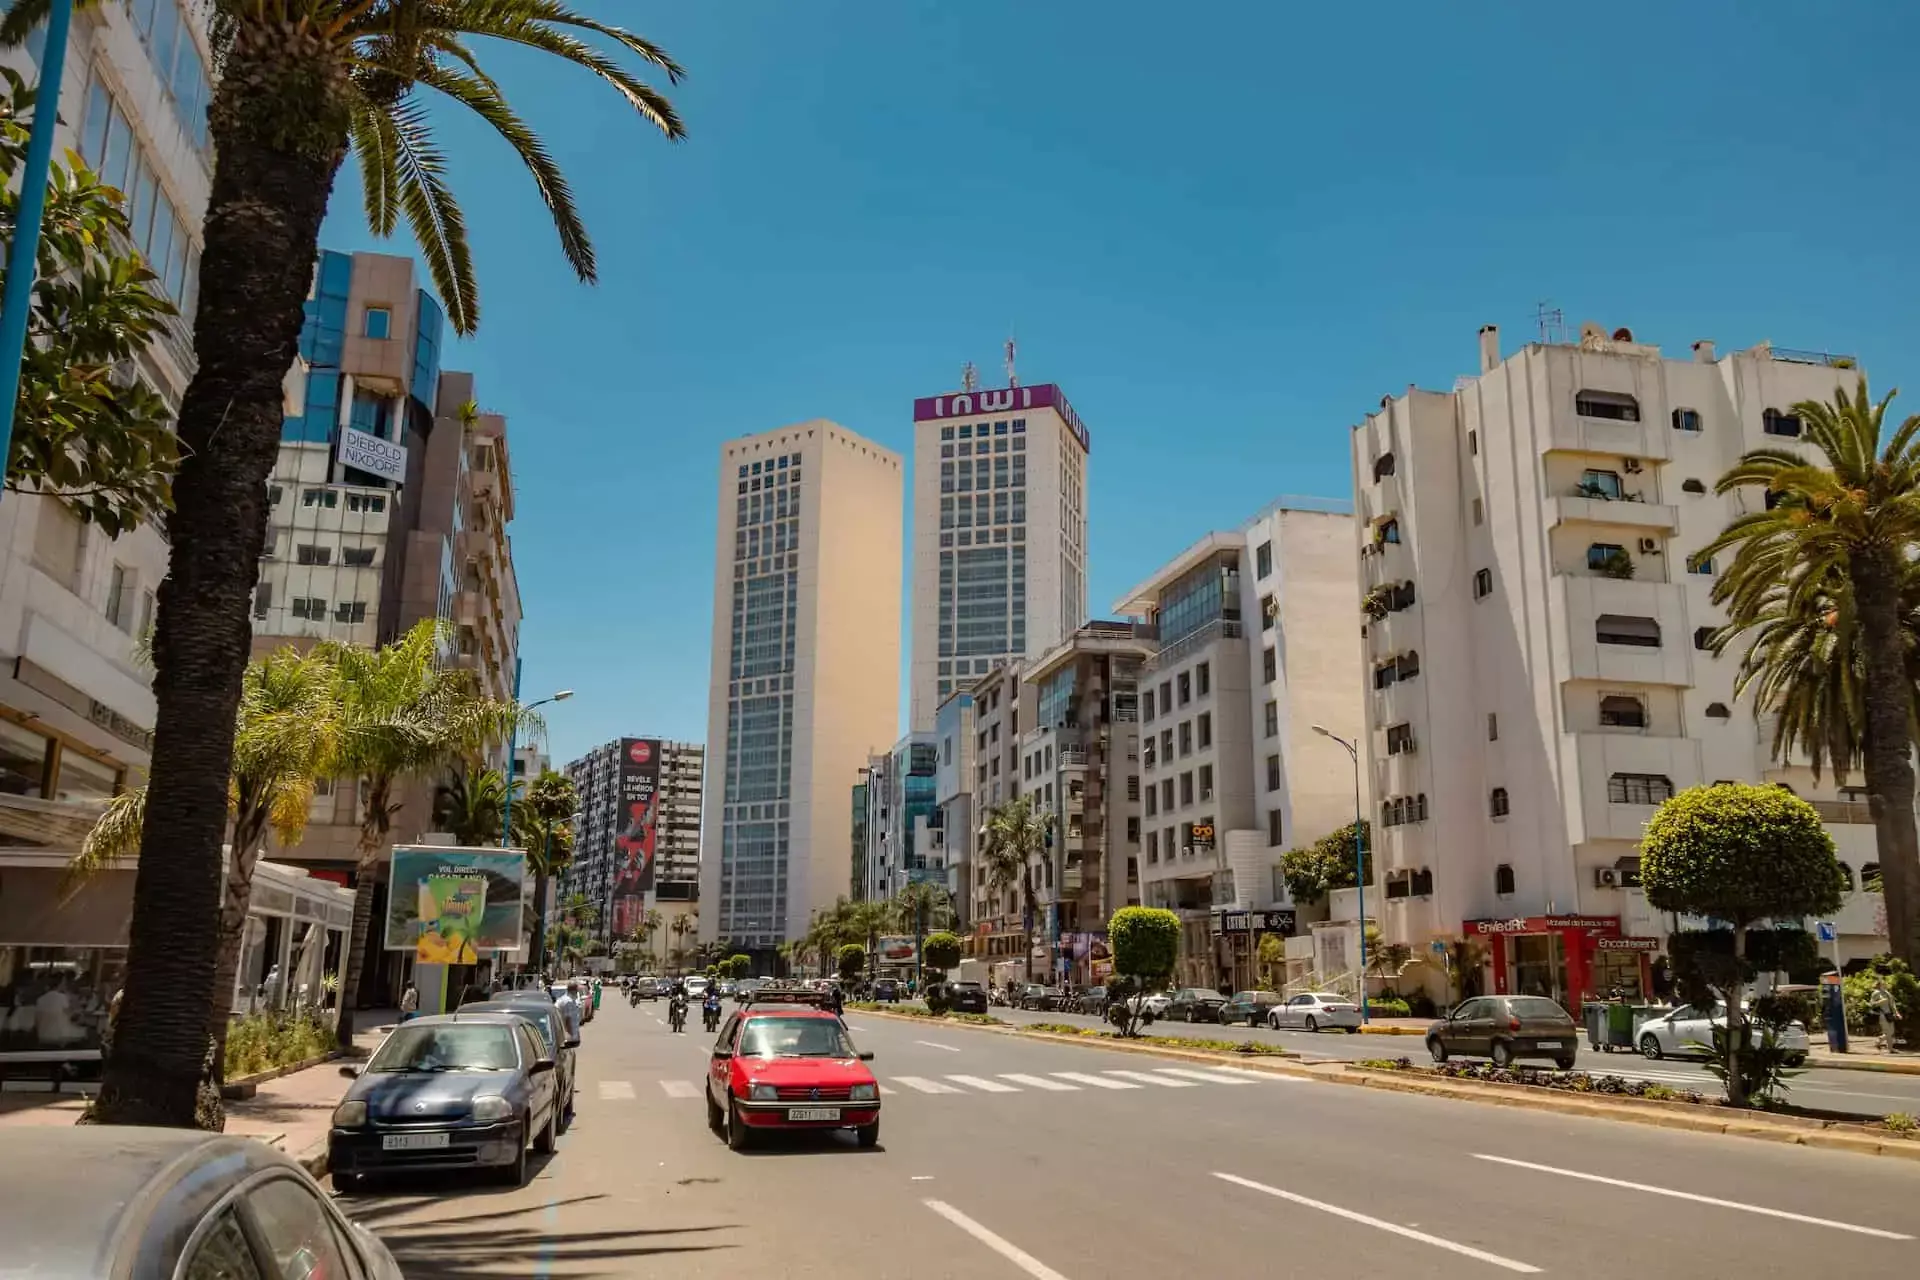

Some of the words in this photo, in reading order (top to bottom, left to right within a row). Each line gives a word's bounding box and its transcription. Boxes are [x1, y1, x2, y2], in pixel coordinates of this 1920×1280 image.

[935, 388, 1031, 416] inwi
[346, 432, 401, 460] DIEBOLD
[345, 447, 400, 473] NIXDORF
[453, 866, 478, 874] DIRECT
